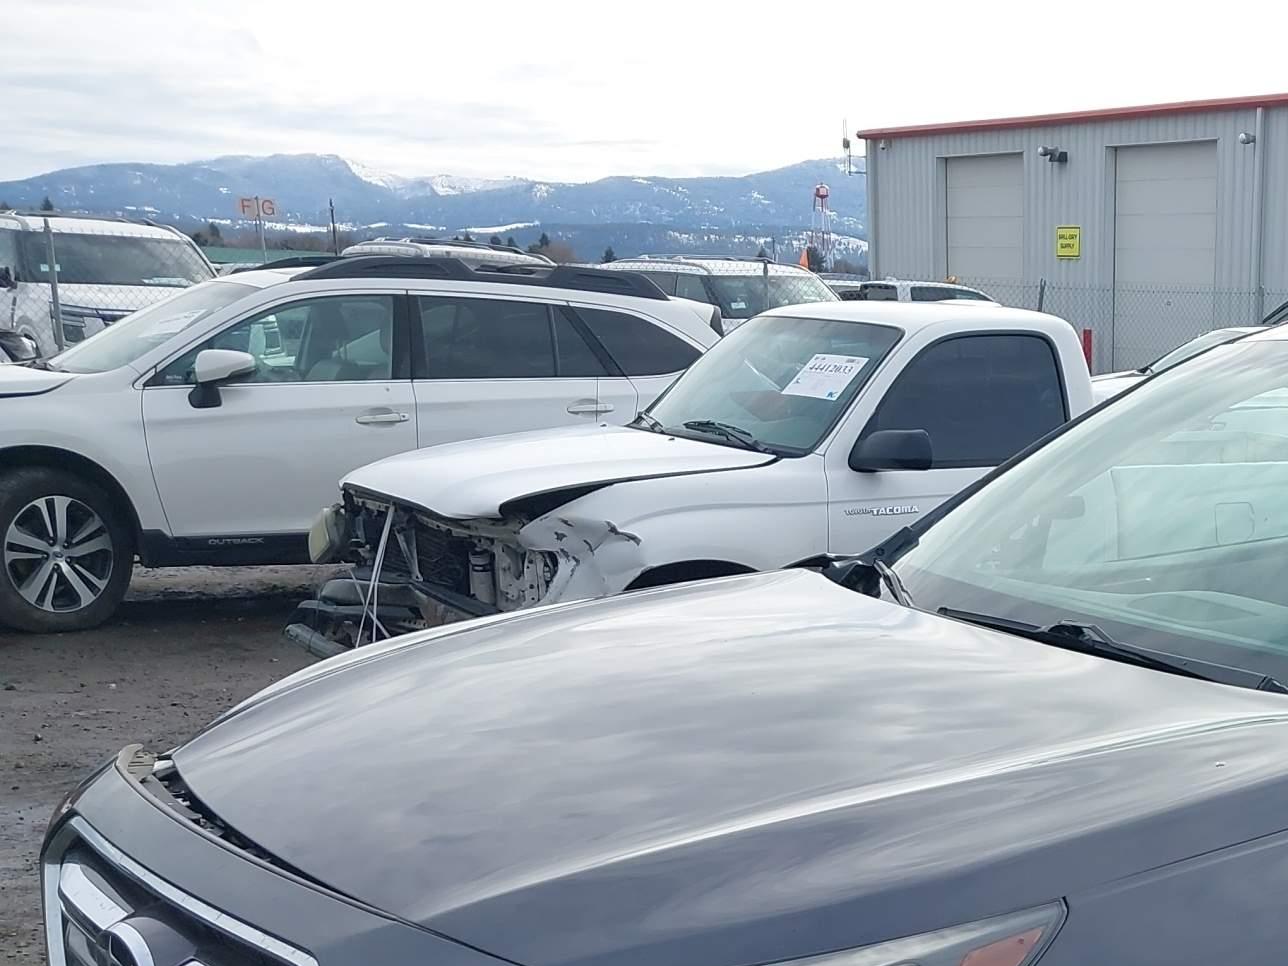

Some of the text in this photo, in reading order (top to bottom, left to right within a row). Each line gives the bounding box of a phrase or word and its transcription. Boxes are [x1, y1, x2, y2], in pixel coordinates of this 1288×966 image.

[241, 198, 275, 216] F G
[871, 505, 919, 516] TACOMA
[207, 537, 265, 545] OUTBACK
